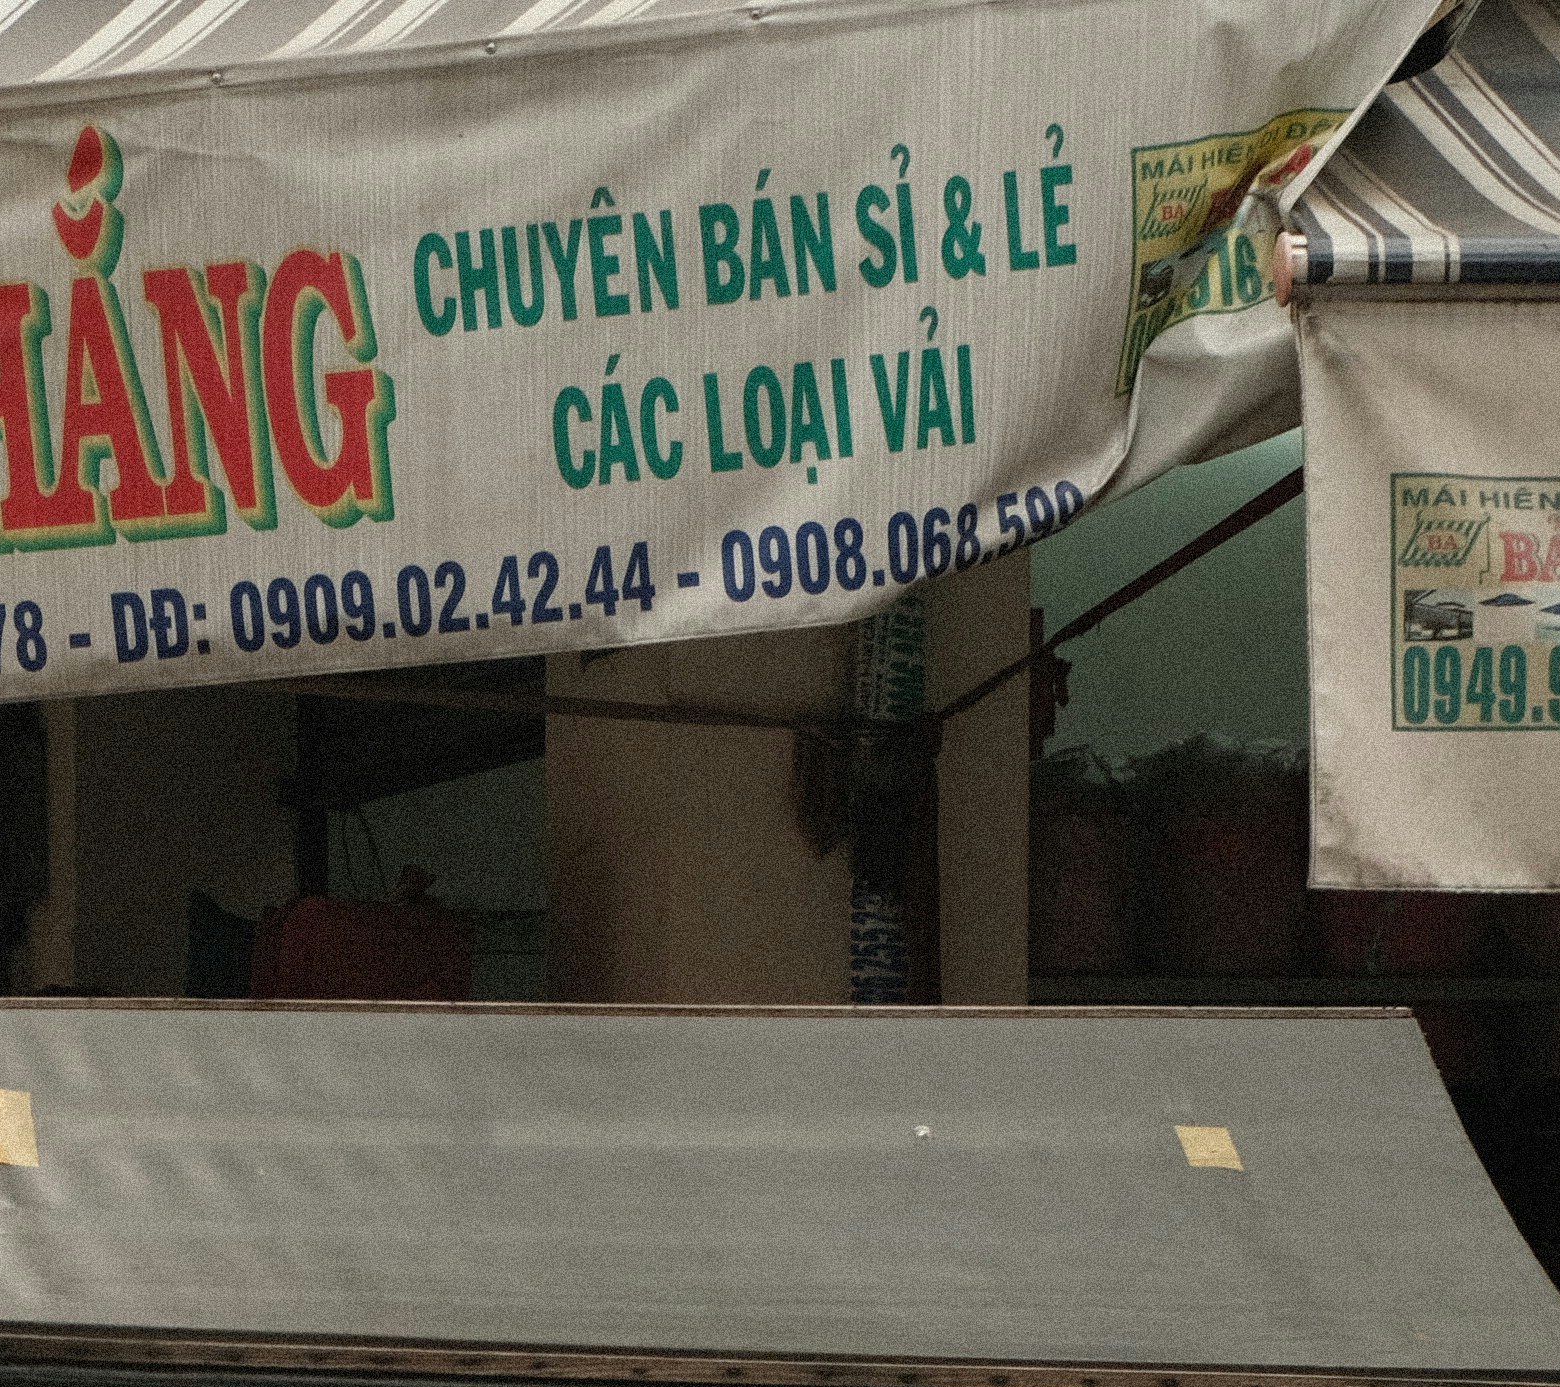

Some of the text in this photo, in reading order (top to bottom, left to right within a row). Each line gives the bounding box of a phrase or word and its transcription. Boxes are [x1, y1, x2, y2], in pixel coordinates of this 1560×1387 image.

[414, 123, 1077, 335] CHUYÊN BÁN SỈ & LẺ
[552, 352, 681, 489] CÁC
[708, 356, 854, 484] LOẠI
[869, 306, 976, 453] VẢI
[112, 582, 211, 664] DĐ:
[231, 538, 656, 654] 0909.02.42.44
[721, 480, 1084, 602] 0908.068.599
[1402, 484, 1467, 508] MÁI
[1425, 533, 1459, 552] BA
